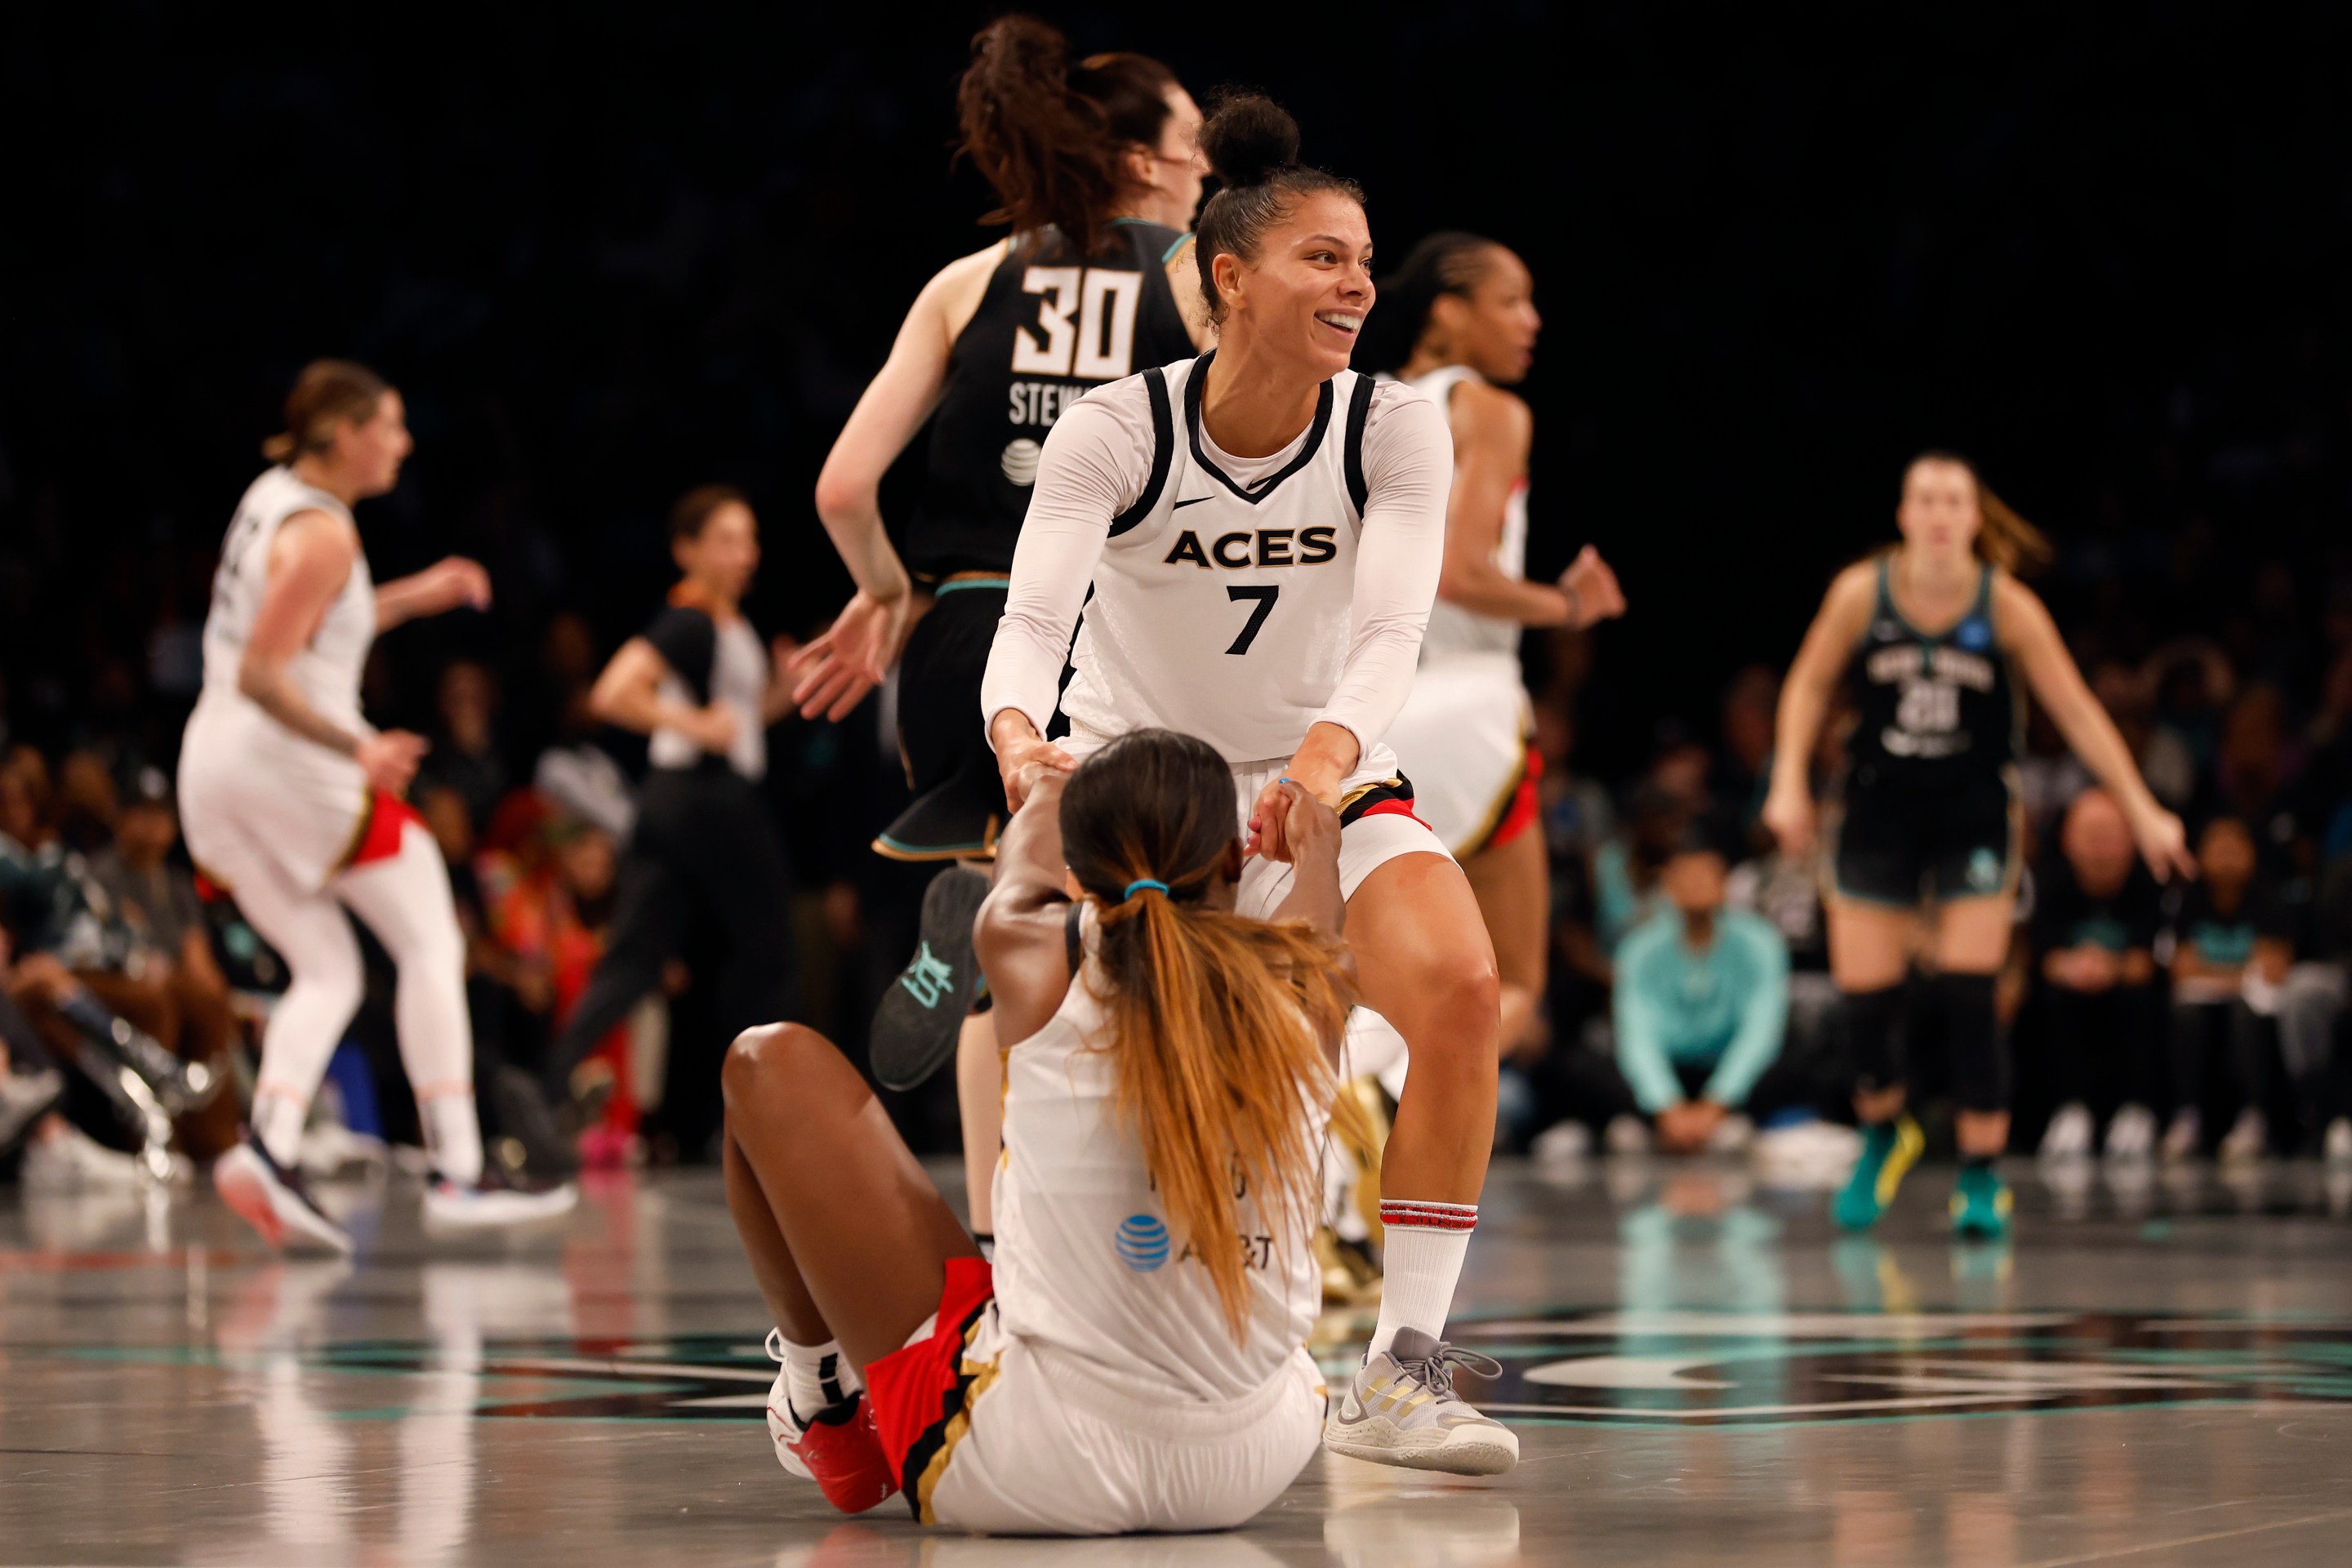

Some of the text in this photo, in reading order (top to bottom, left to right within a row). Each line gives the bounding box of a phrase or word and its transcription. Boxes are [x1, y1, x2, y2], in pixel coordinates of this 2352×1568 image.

[1011, 266, 1143, 379] 30
[1162, 526, 1338, 569] ACES
[1224, 585, 1280, 656] 7
